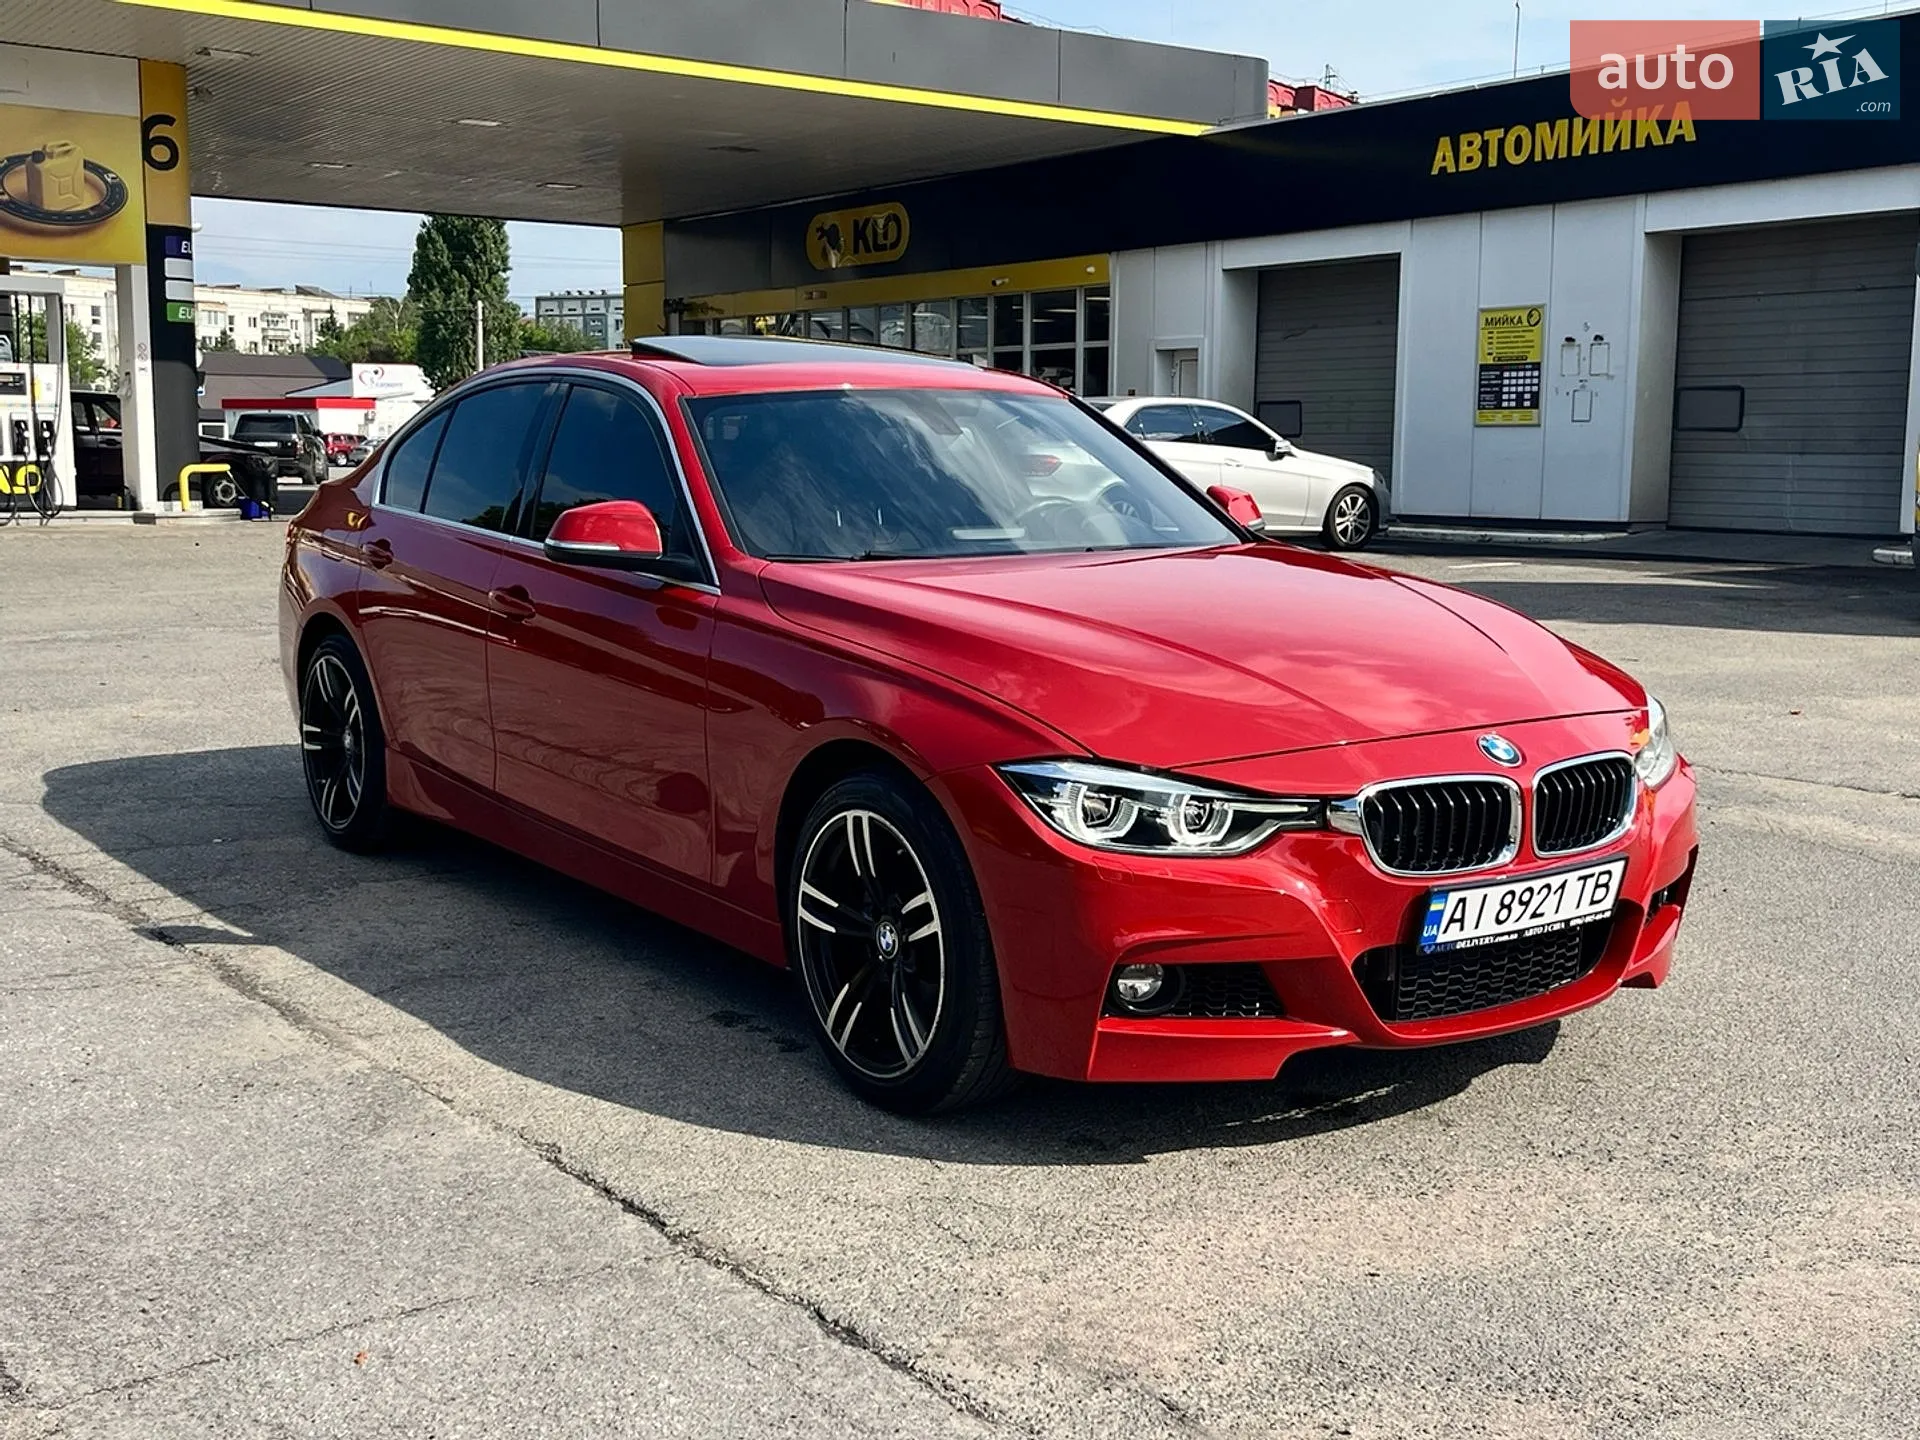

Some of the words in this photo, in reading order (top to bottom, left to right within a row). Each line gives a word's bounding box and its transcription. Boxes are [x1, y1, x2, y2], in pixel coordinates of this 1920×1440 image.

[142, 114, 179, 171] 6
[1431, 97, 1696, 176] АВТОМИЙКА
[852, 213, 902, 255] KLO
[1484, 314, 1523, 327] МИЙКА
[1443, 894, 1488, 934] AI
[1495, 879, 1567, 925] 8921
[1575, 870, 1613, 908] TB
[1423, 924, 1438, 937] UA
